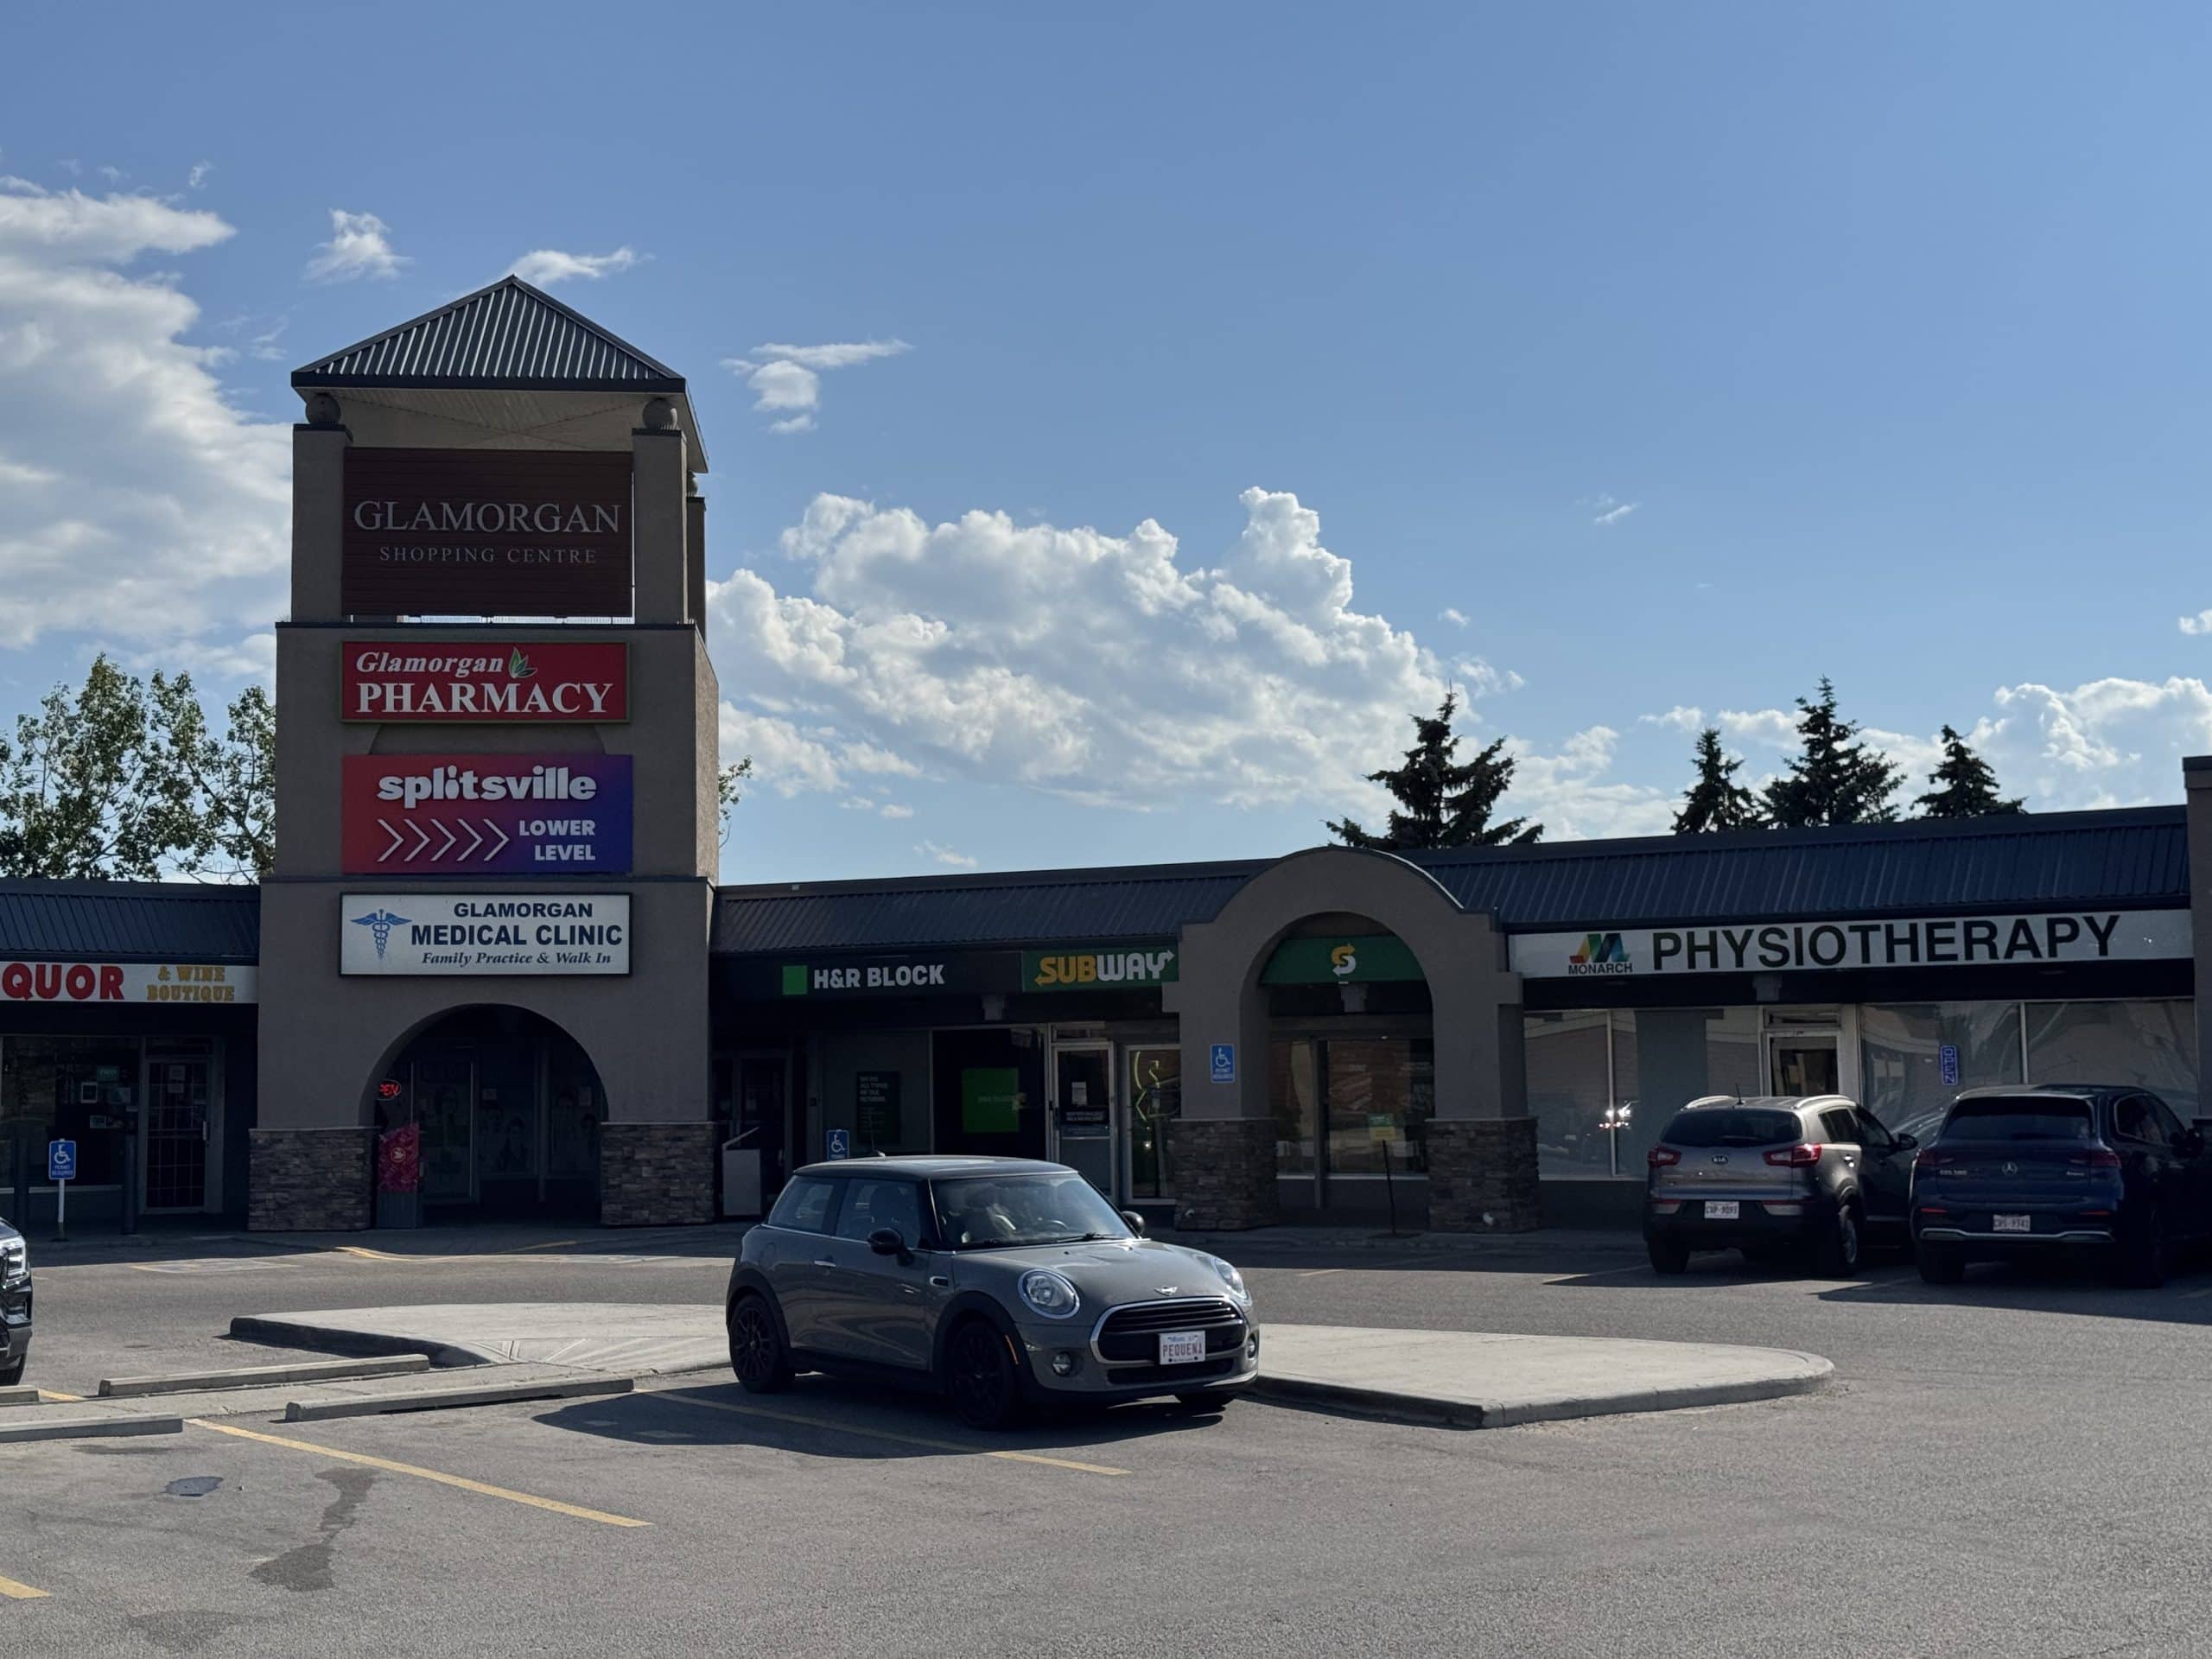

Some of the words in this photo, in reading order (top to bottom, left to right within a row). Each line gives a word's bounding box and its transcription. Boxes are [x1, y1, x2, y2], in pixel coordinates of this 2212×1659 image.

[354, 500, 622, 533] GLAMORGAN
[380, 546, 495, 563] SHOPPING
[507, 549, 597, 563] CENTRE
[356, 652, 504, 678] Glamorgan
[356, 683, 613, 713] PHARMACY
[377, 766, 597, 809] splitsville
[519, 820, 595, 836] LOWER
[535, 844, 595, 861] LEVEL
[454, 903, 593, 918] GLAMORGAN
[410, 925, 527, 946] MEDICAL
[536, 925, 622, 945] CLINIC
[1653, 915, 2120, 971] PHYSIOTHERAPY
[422, 953, 472, 968] Family
[476, 953, 532, 964] Practice
[537, 953, 550, 964] &
[556, 952, 592, 964] Walk
[595, 953, 611, 964] In
[1034, 949, 1175, 987] SUBWAY
[1568, 962, 1633, 976] MONARCH
[2, 963, 124, 1001] QUOR
[158, 966, 171, 982] &
[176, 966, 226, 982] WINE
[814, 968, 861, 989] H&R
[867, 964, 945, 988] BLOCK
[147, 985, 235, 1002] BOUTIQUE
